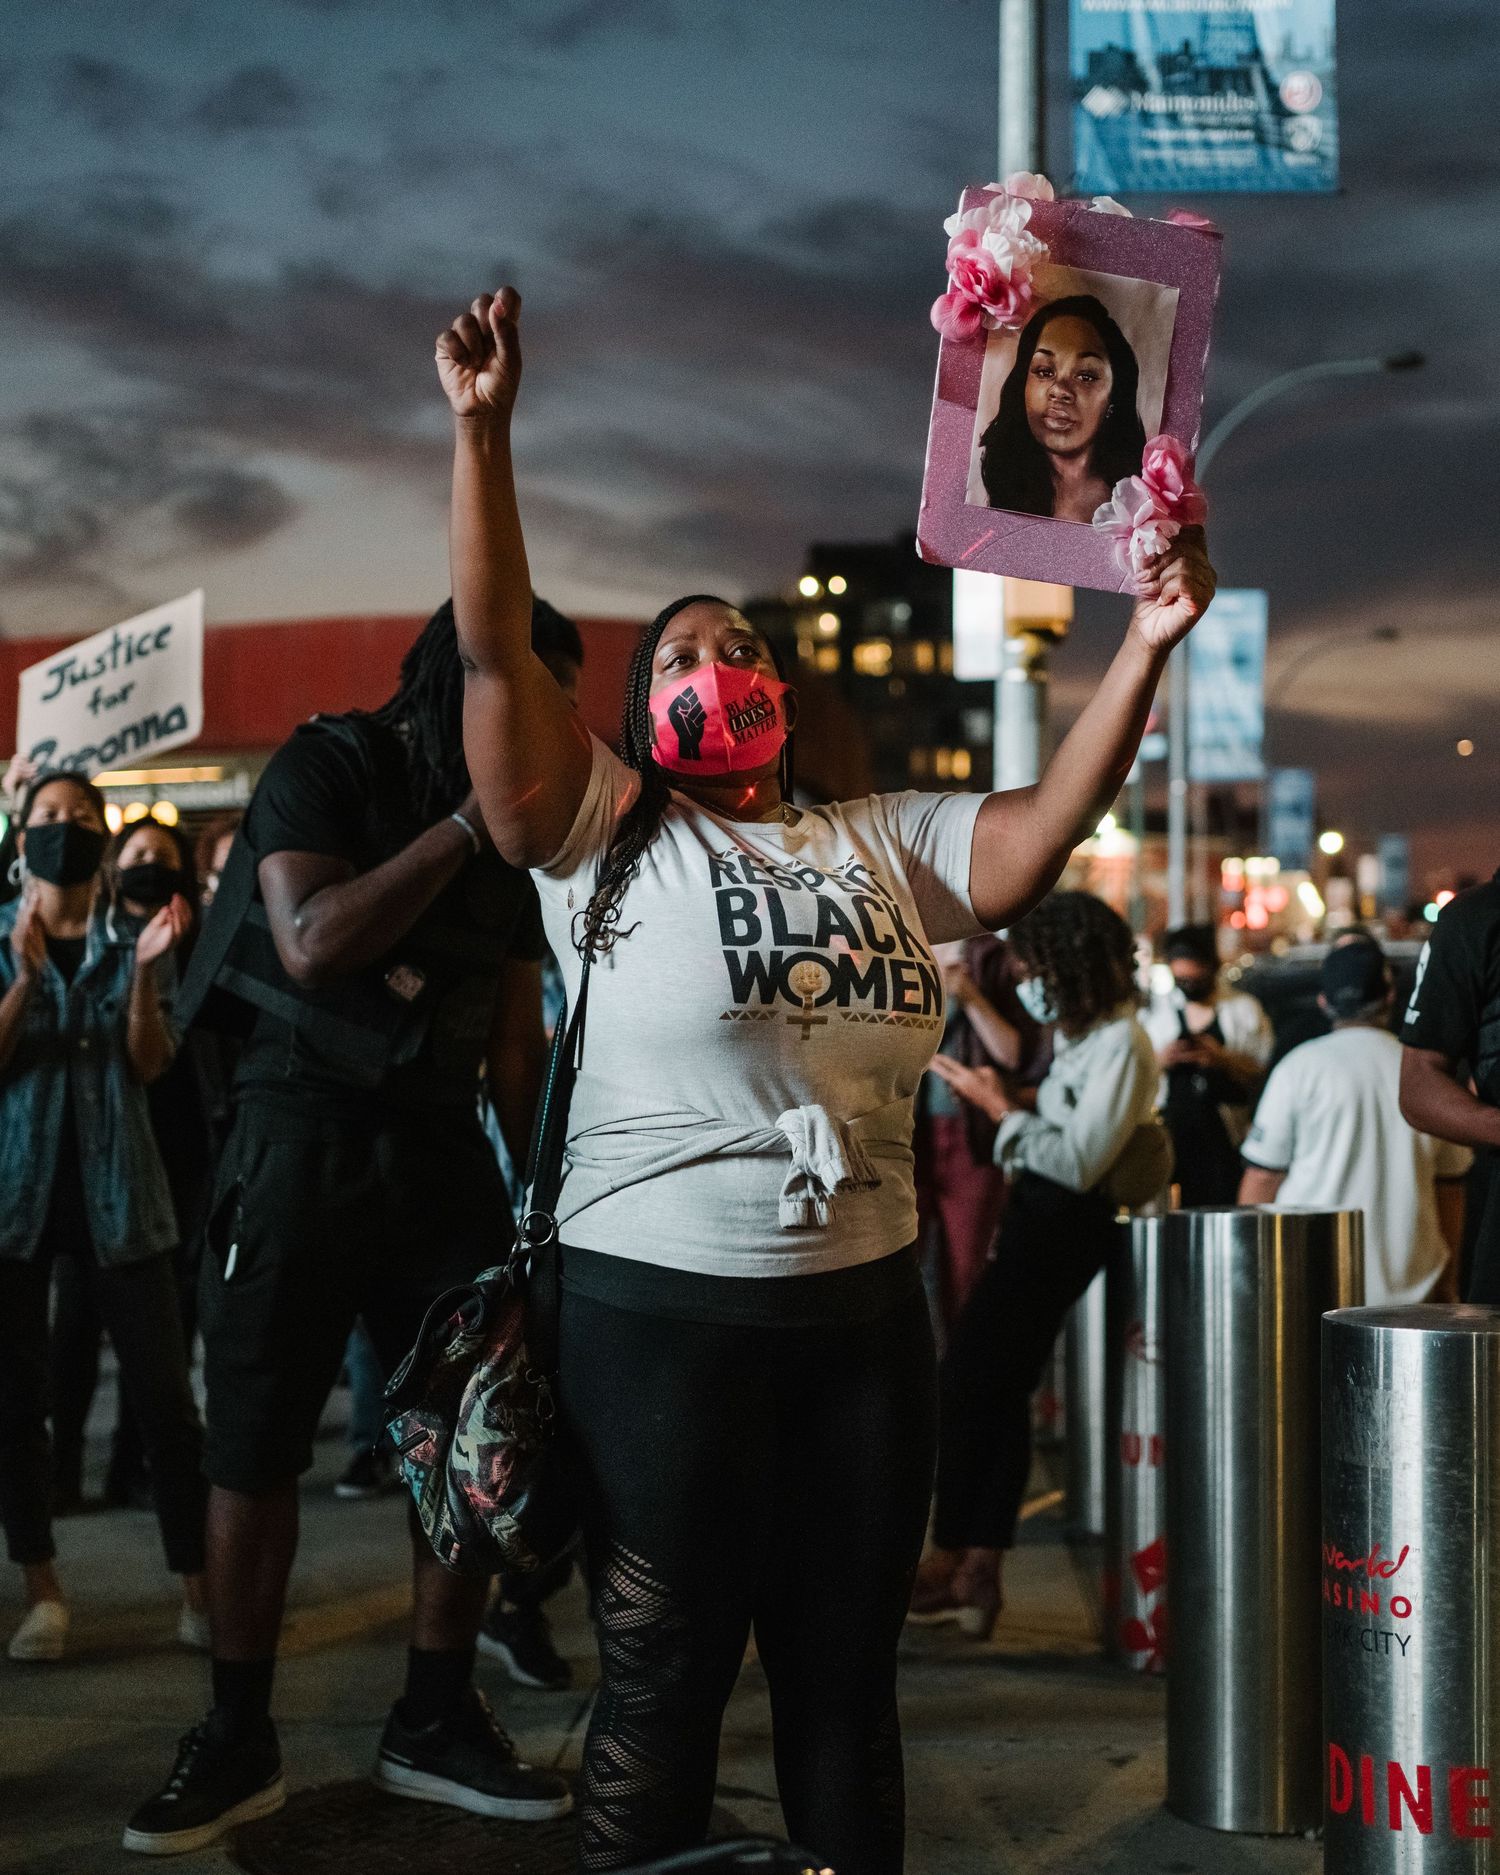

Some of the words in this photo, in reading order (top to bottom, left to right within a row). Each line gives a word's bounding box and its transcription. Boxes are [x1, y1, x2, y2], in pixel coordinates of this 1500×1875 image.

[41, 623, 172, 702] Justice
[88, 681, 136, 715] for
[724, 685, 769, 717] BLACK
[731, 705, 766, 731] LIVES
[734, 715, 778, 748] MATTER
[715, 887, 930, 961] BLACK
[722, 949, 942, 1017] WOMEN
[1360, 1628, 1412, 1657] CITY
[1329, 1742, 1494, 1839] DINE
